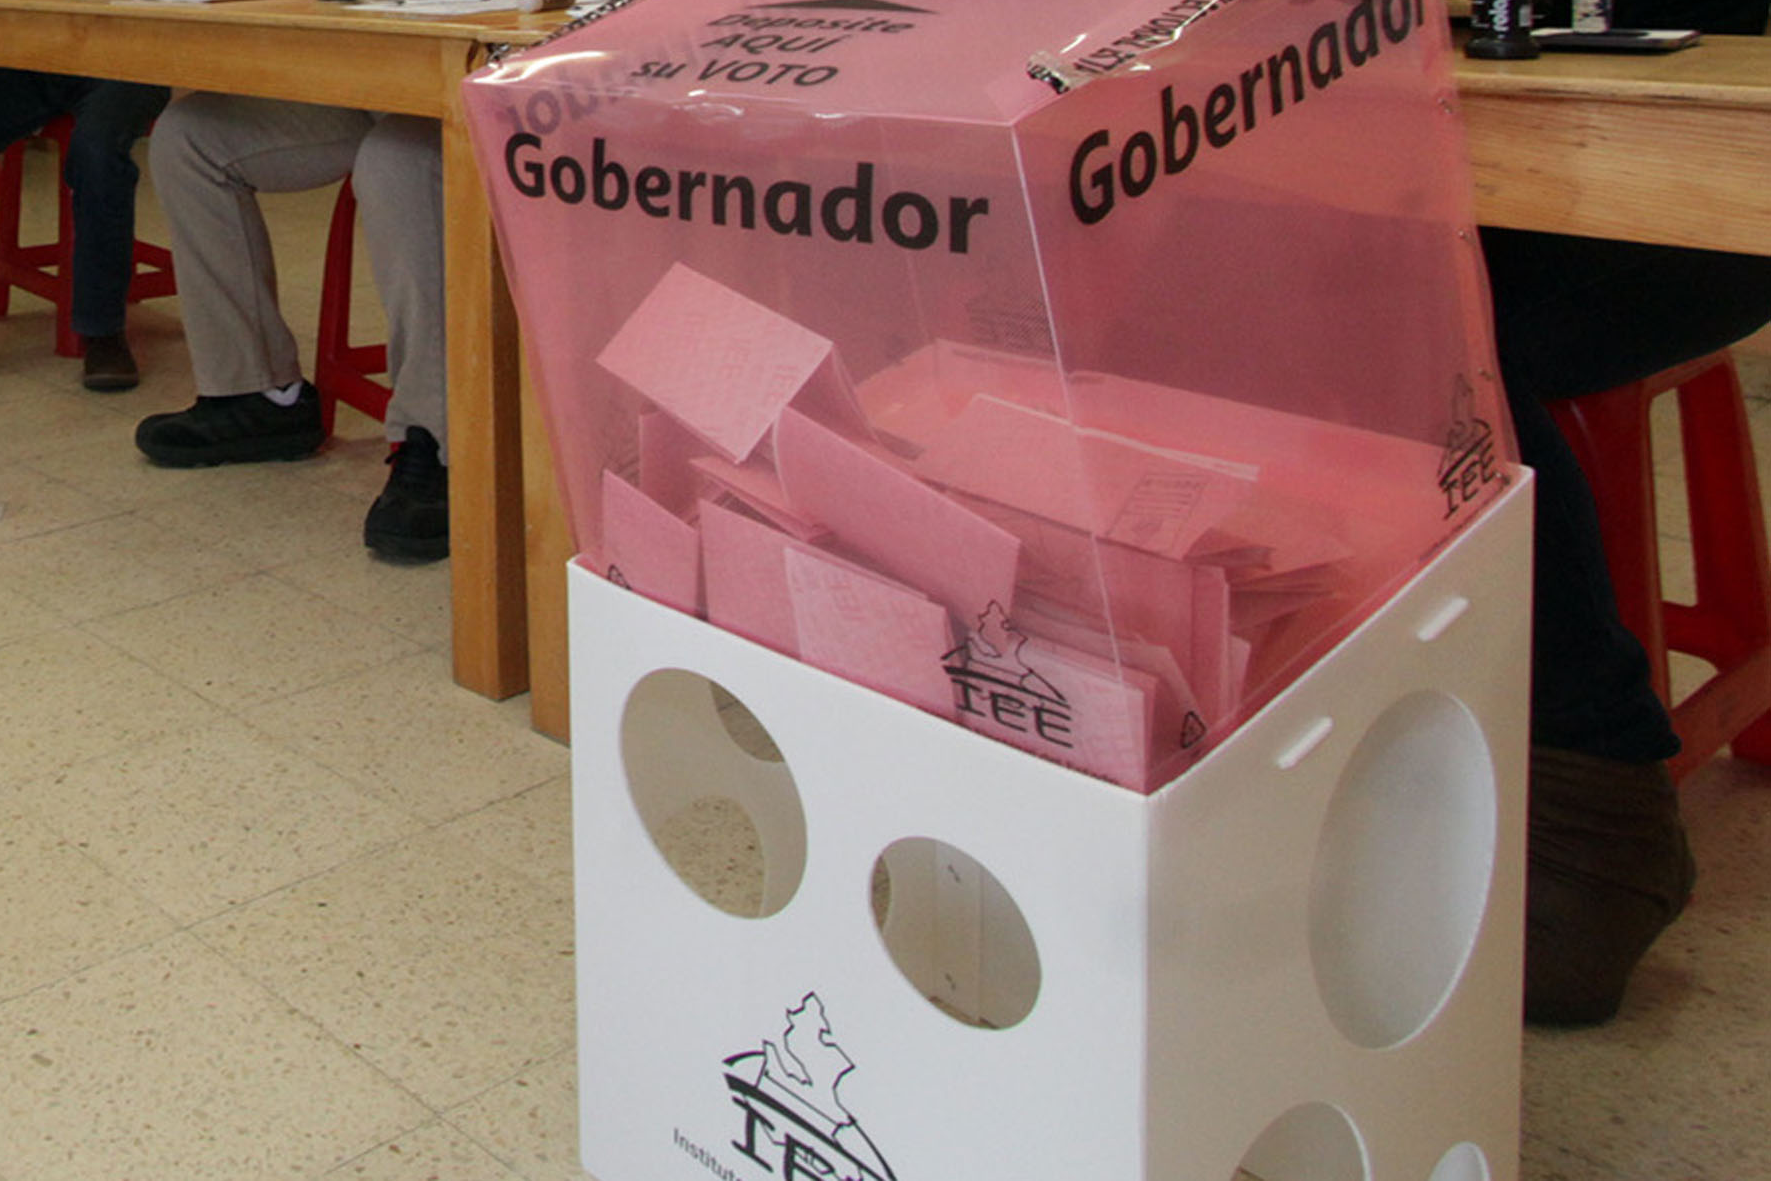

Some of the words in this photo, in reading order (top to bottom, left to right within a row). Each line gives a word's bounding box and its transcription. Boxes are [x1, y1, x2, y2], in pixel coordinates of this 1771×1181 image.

[631, 60, 688, 80] su
[697, 59, 839, 86] VOTO
[503, 131, 990, 256] Gobernador
[950, 677, 1074, 749] IEE
[673, 1127, 742, 1181] Institut
[731, 1095, 850, 1181] IE
